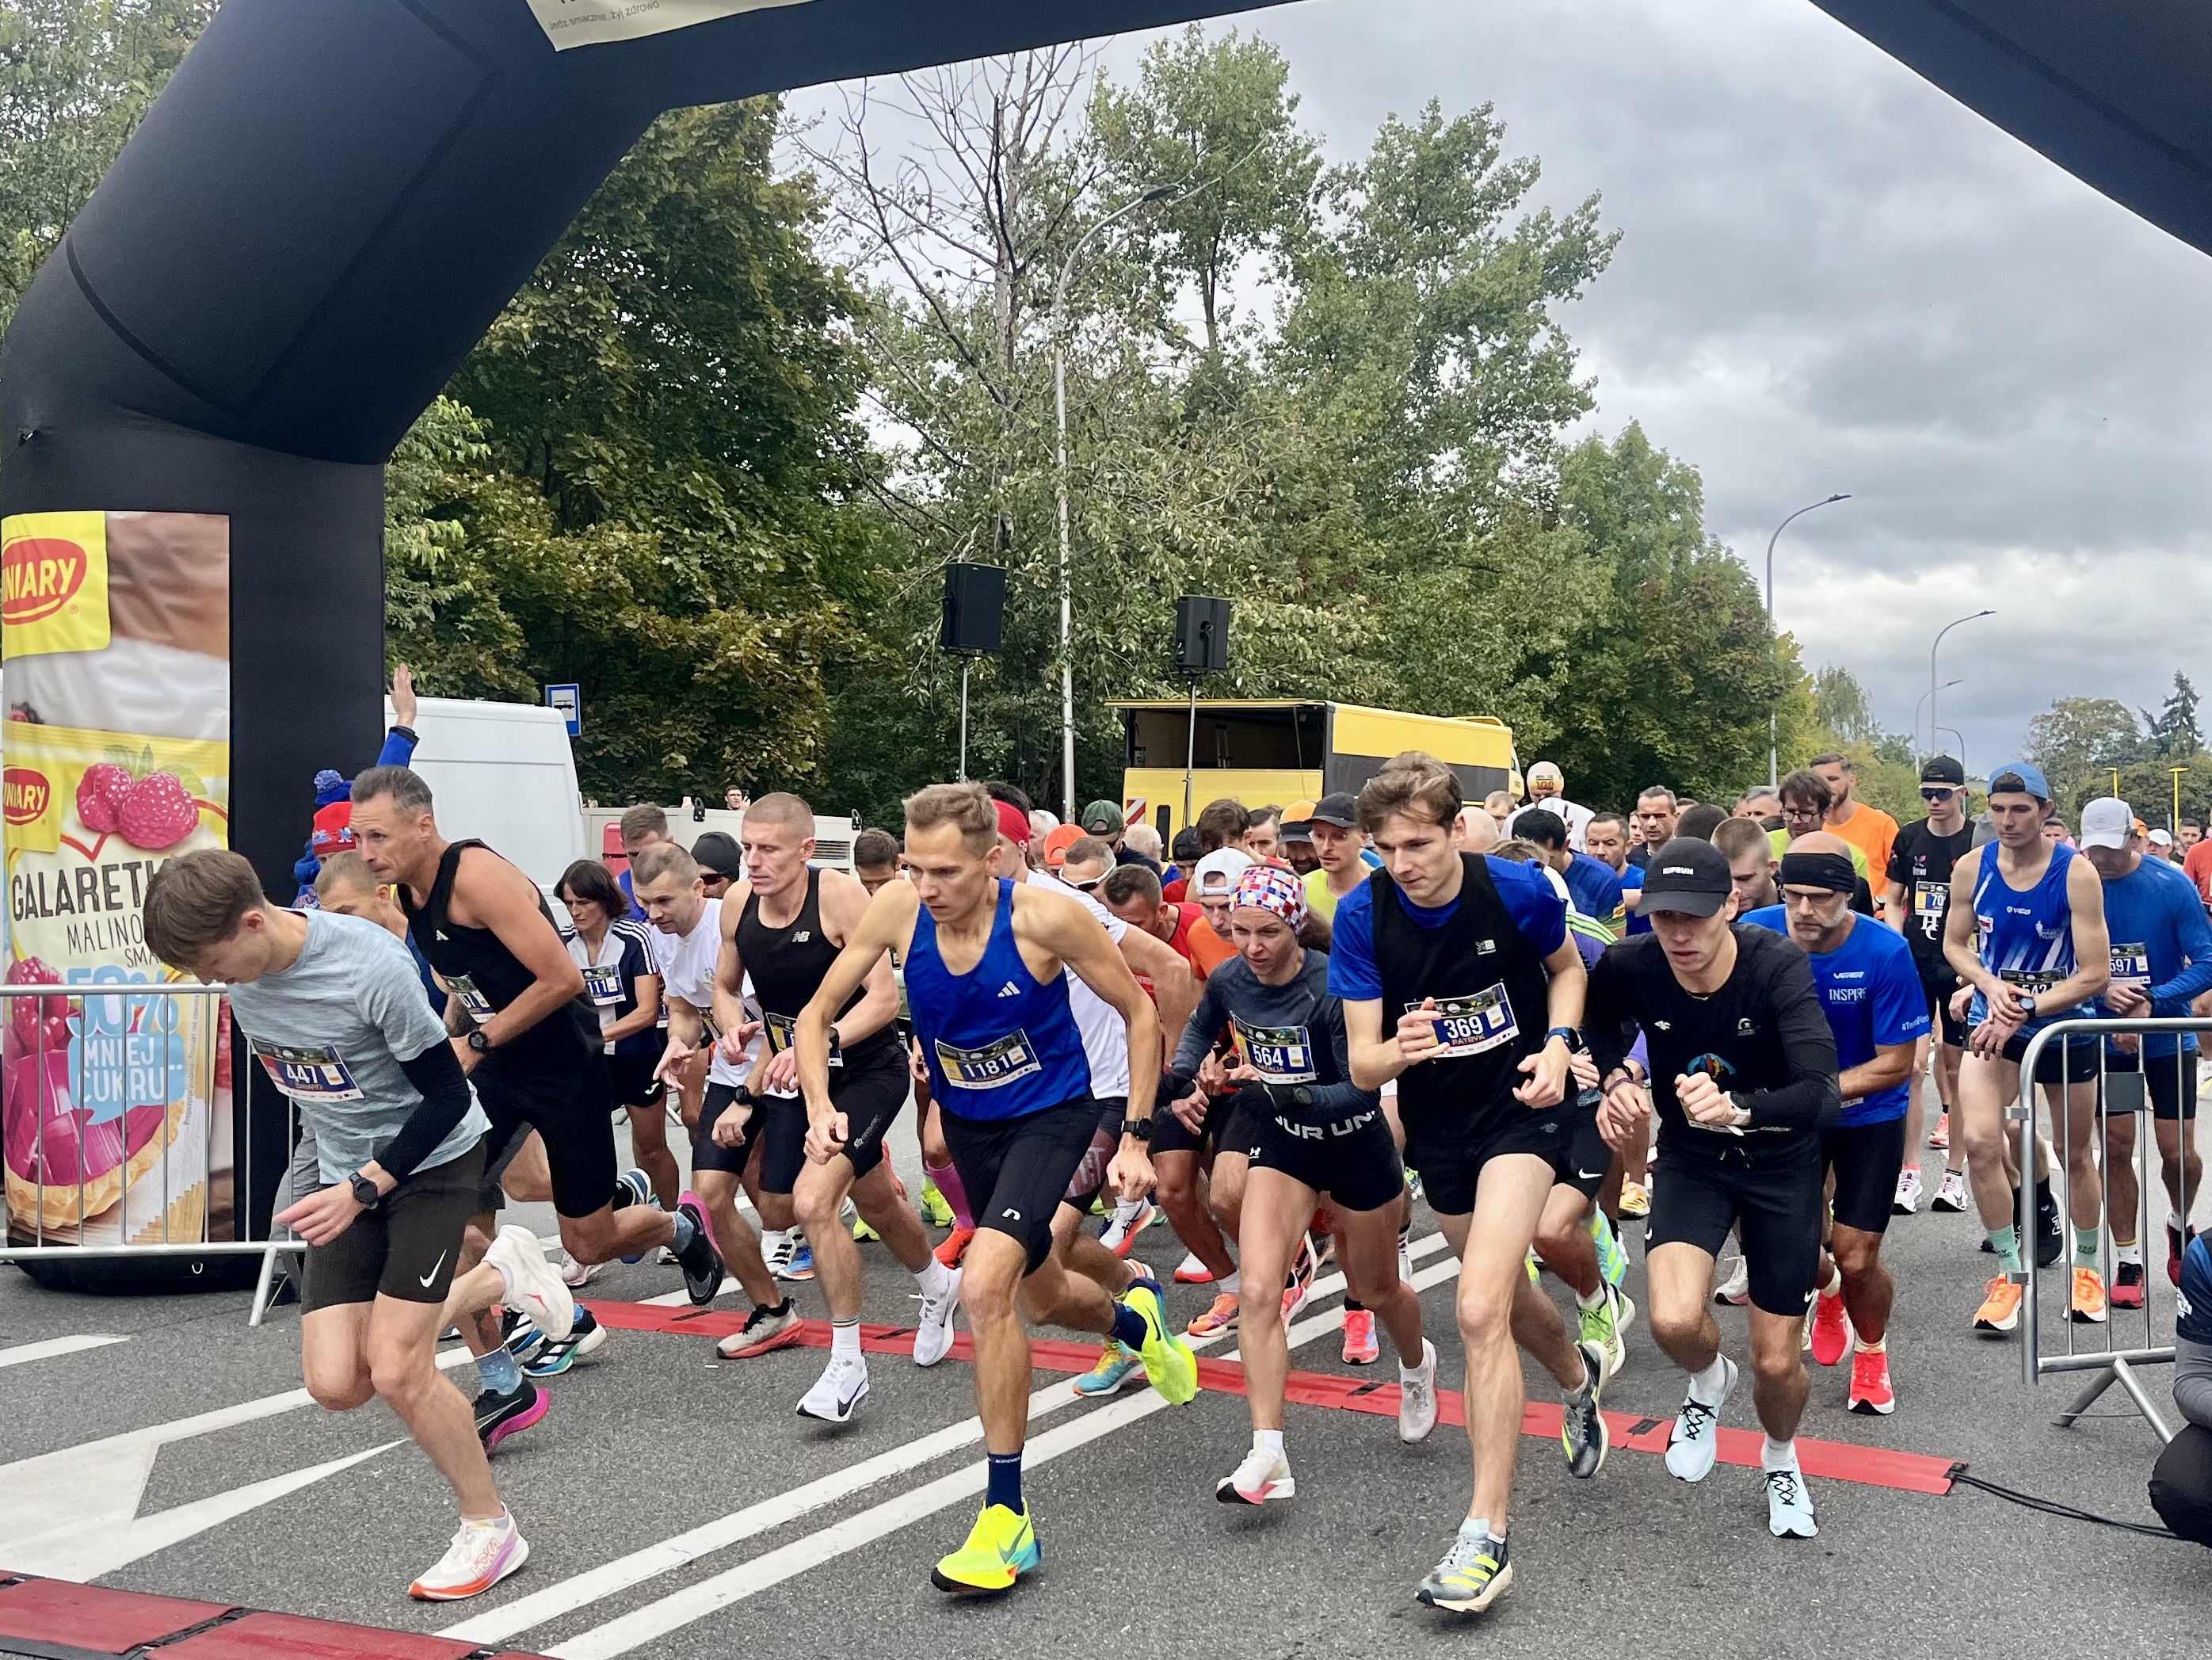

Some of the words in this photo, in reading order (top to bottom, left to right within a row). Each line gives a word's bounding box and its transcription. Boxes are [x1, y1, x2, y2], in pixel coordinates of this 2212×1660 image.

[548, 18, 570, 30] Jedz
[610, 10, 624, 21] żyj
[625, 1, 661, 17] zdrowo
[67, 965, 179, 1039] 50%
[1444, 1015, 1484, 1040] 369
[83, 1036, 154, 1067] MNIEJ
[1252, 1044, 1283, 1067] 564
[286, 1063, 318, 1084] 447
[963, 1055, 1010, 1078] 1181
